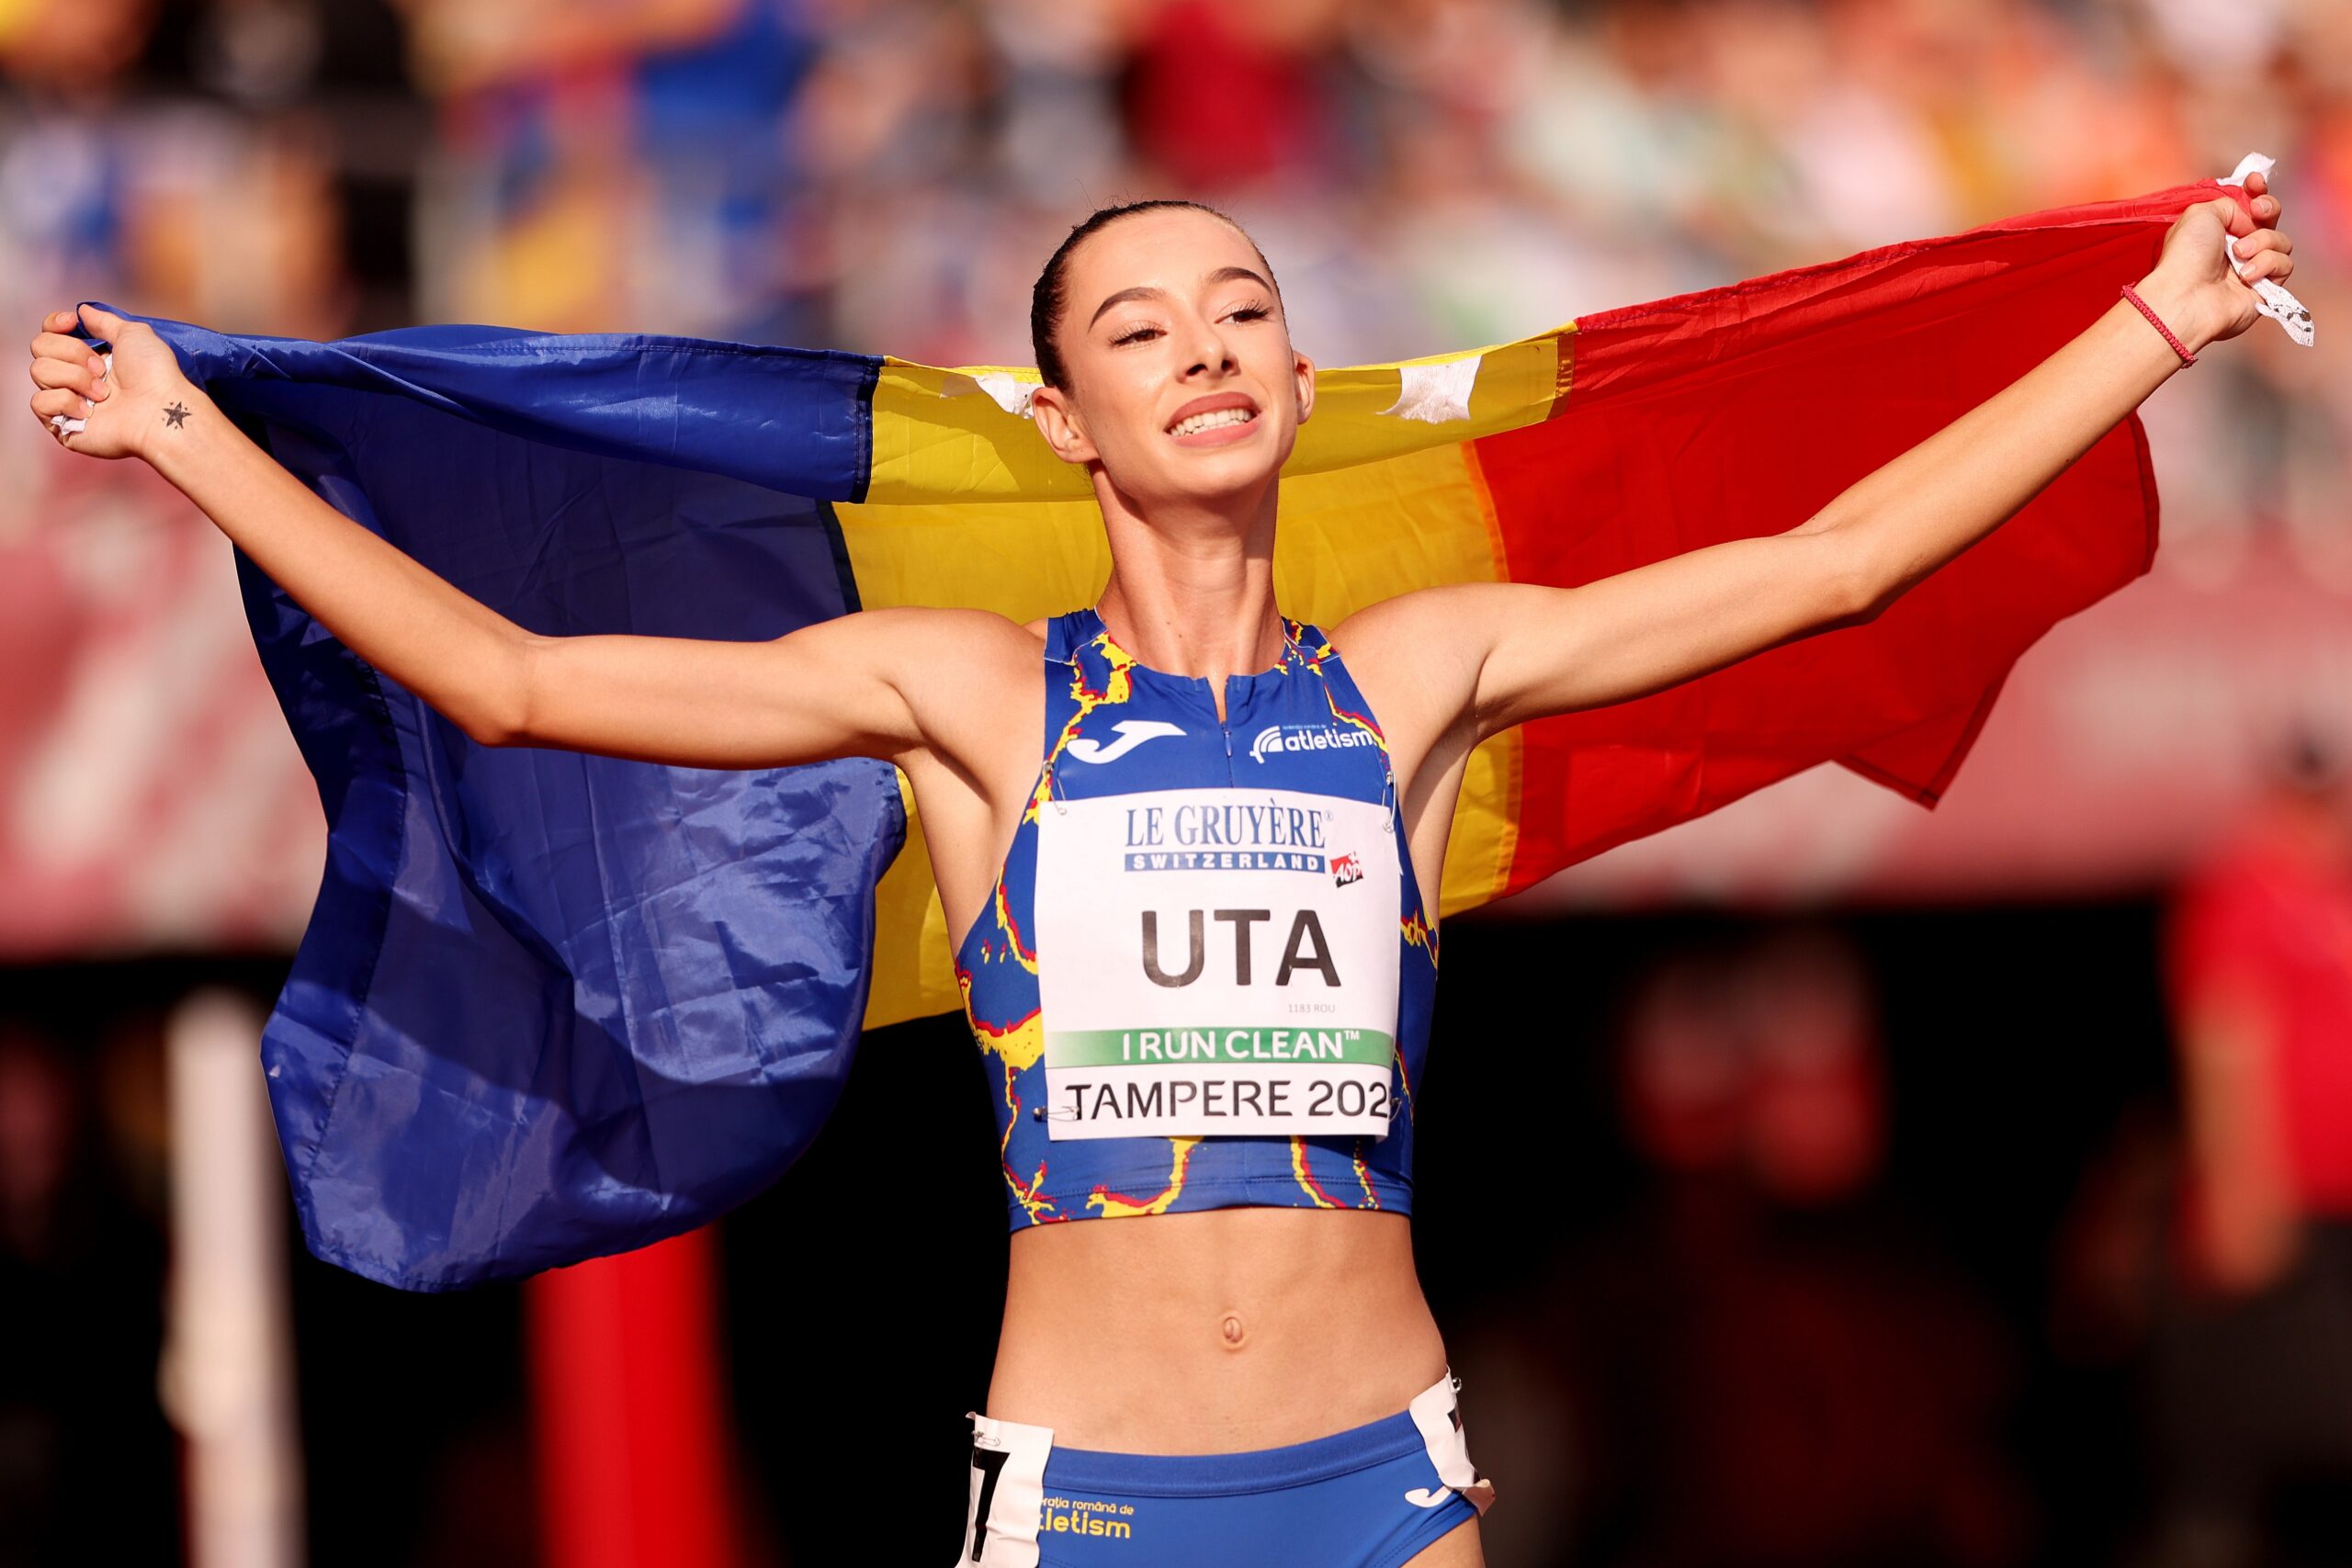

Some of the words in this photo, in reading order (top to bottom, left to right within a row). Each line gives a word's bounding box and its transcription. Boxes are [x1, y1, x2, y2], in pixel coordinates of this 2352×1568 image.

[1284, 728, 1374, 751] atletism
[1125, 807, 1164, 847] LE
[1133, 853, 1319, 871] SWITZERLAND
[1334, 862, 1362, 883] AOP
[1141, 908, 1341, 987] UTA
[1288, 1003, 1311, 1013] 1183
[1314, 1003, 1336, 1013] ROU
[1123, 1032, 1130, 1061] I
[1139, 1032, 1216, 1060] RUN
[1064, 1079, 1293, 1121] TAMPERE
[1308, 1079, 1391, 1119] 202
[972, 1446, 1012, 1562] 7
[1042, 1496, 1069, 1508] rația
[1072, 1501, 1118, 1514] română
[1119, 1505, 1135, 1516] de
